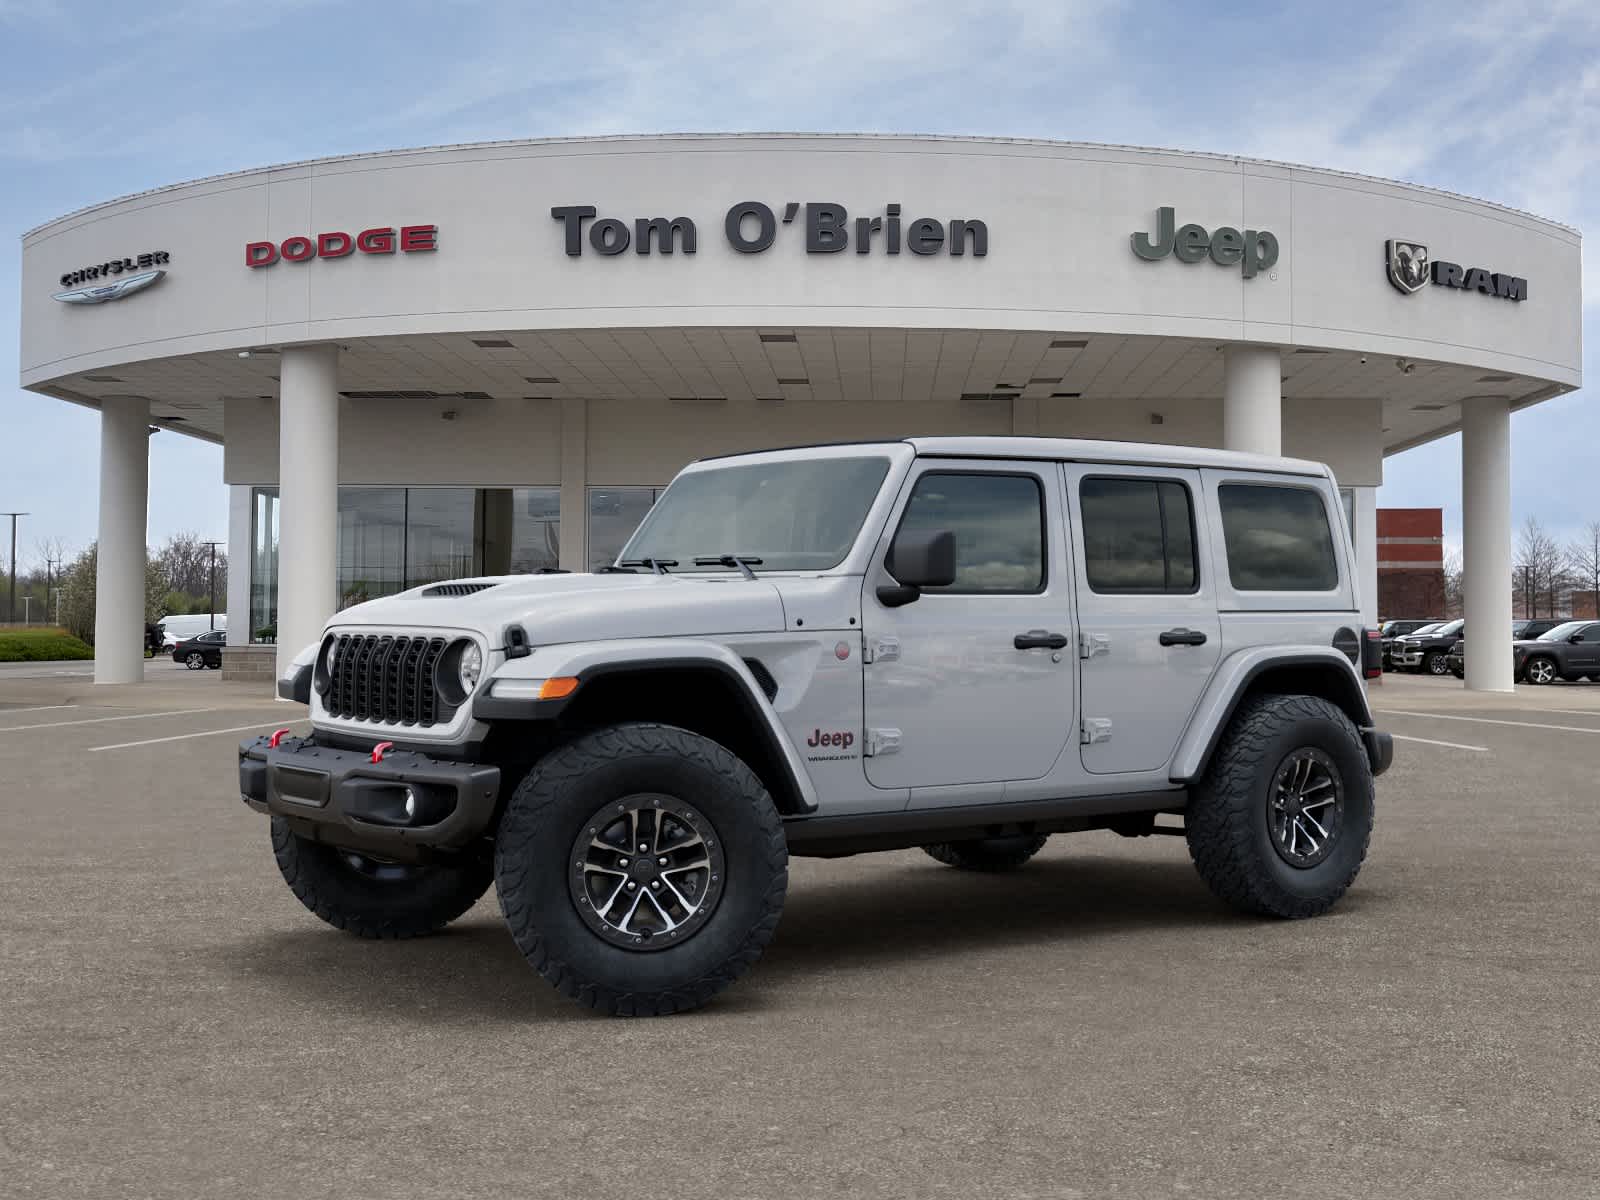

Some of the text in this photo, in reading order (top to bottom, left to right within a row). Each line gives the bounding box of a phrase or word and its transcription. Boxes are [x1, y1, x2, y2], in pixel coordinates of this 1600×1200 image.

[246, 224, 438, 268] DODGE
[551, 201, 988, 256] Tom O'Brien
[1130, 206, 1279, 279] Jeep
[60, 250, 170, 286] CHRYSLER
[1430, 260, 1527, 301] RAM
[807, 728, 854, 749] Jeep
